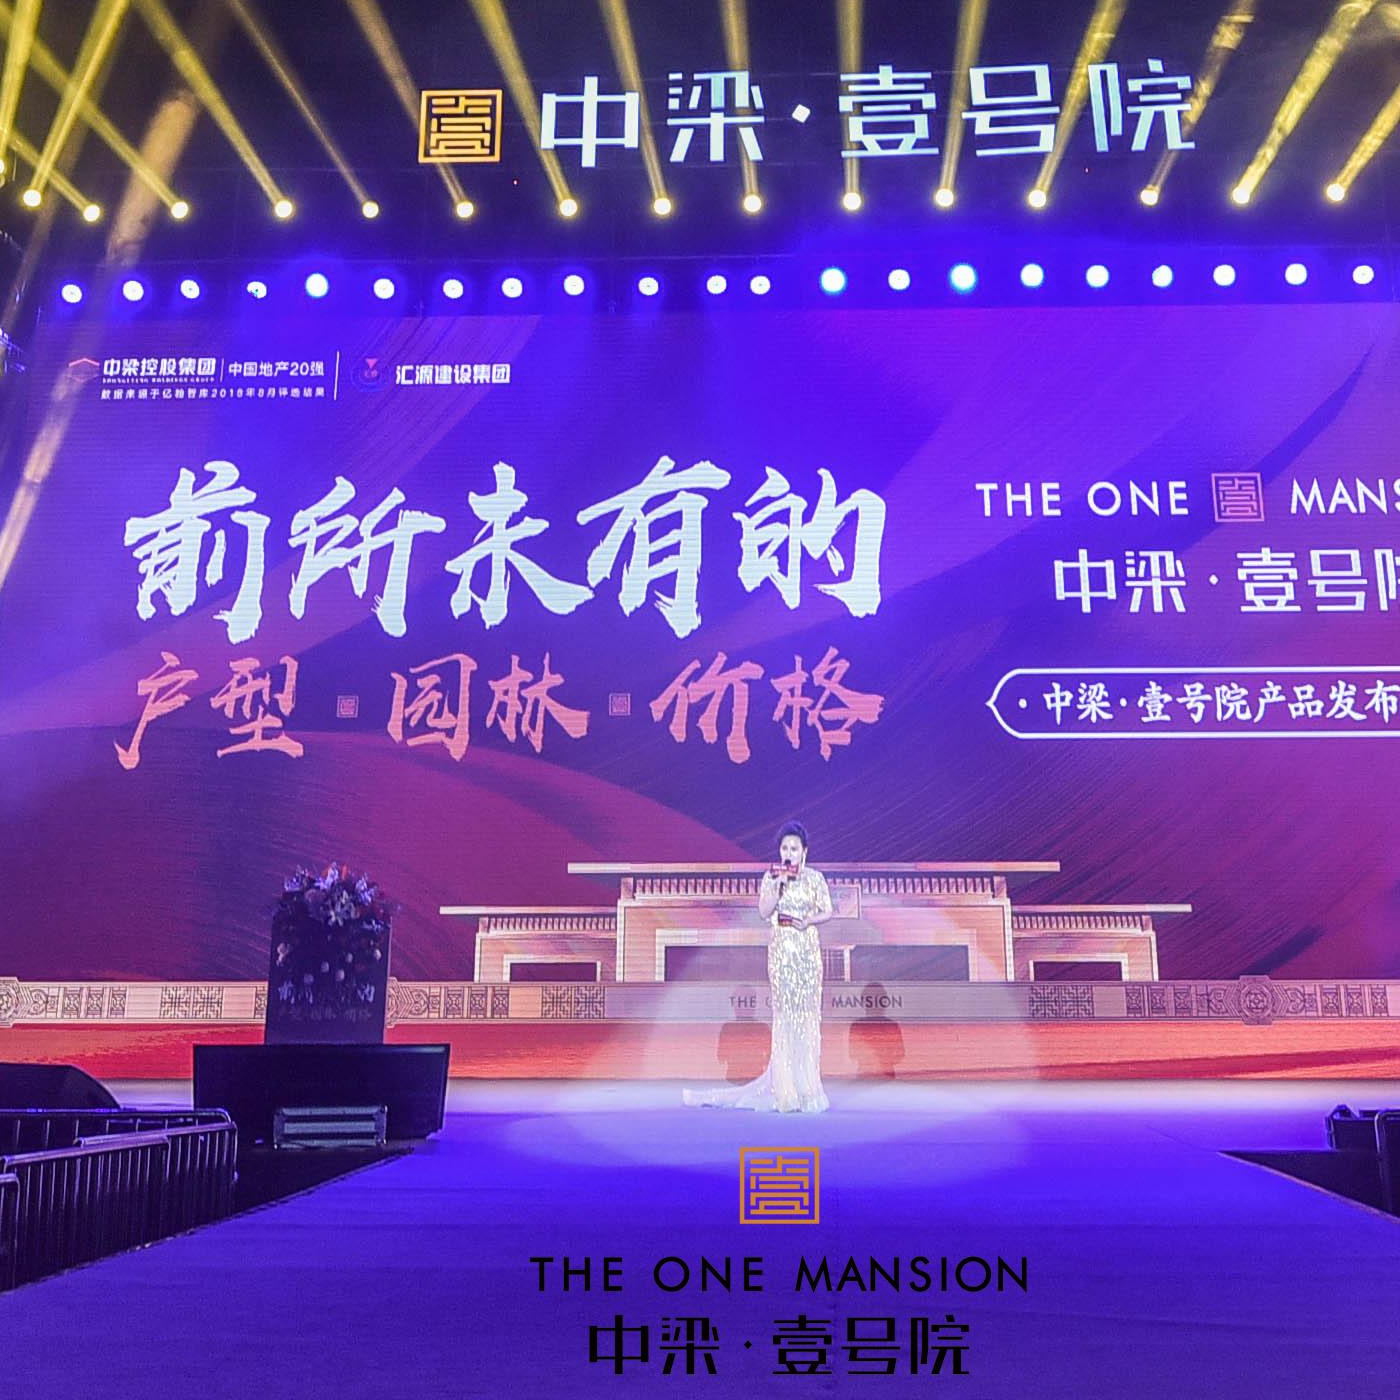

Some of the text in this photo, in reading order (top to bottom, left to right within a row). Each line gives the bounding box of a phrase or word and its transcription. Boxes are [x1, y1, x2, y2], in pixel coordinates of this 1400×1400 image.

[540, 59, 1195, 167] 中梁·壹号院
[103, 357, 511, 385] 中梁控股集团 中国地产20强 汇源建设集团
[975, 481, 1061, 517] THE
[1087, 480, 1189, 517] ONE
[124, 455, 887, 643] 前所未有的
[113, 645, 887, 770] 户型 园林 价格
[729, 995, 756, 1008] THE
[831, 995, 903, 1008] MANSION
